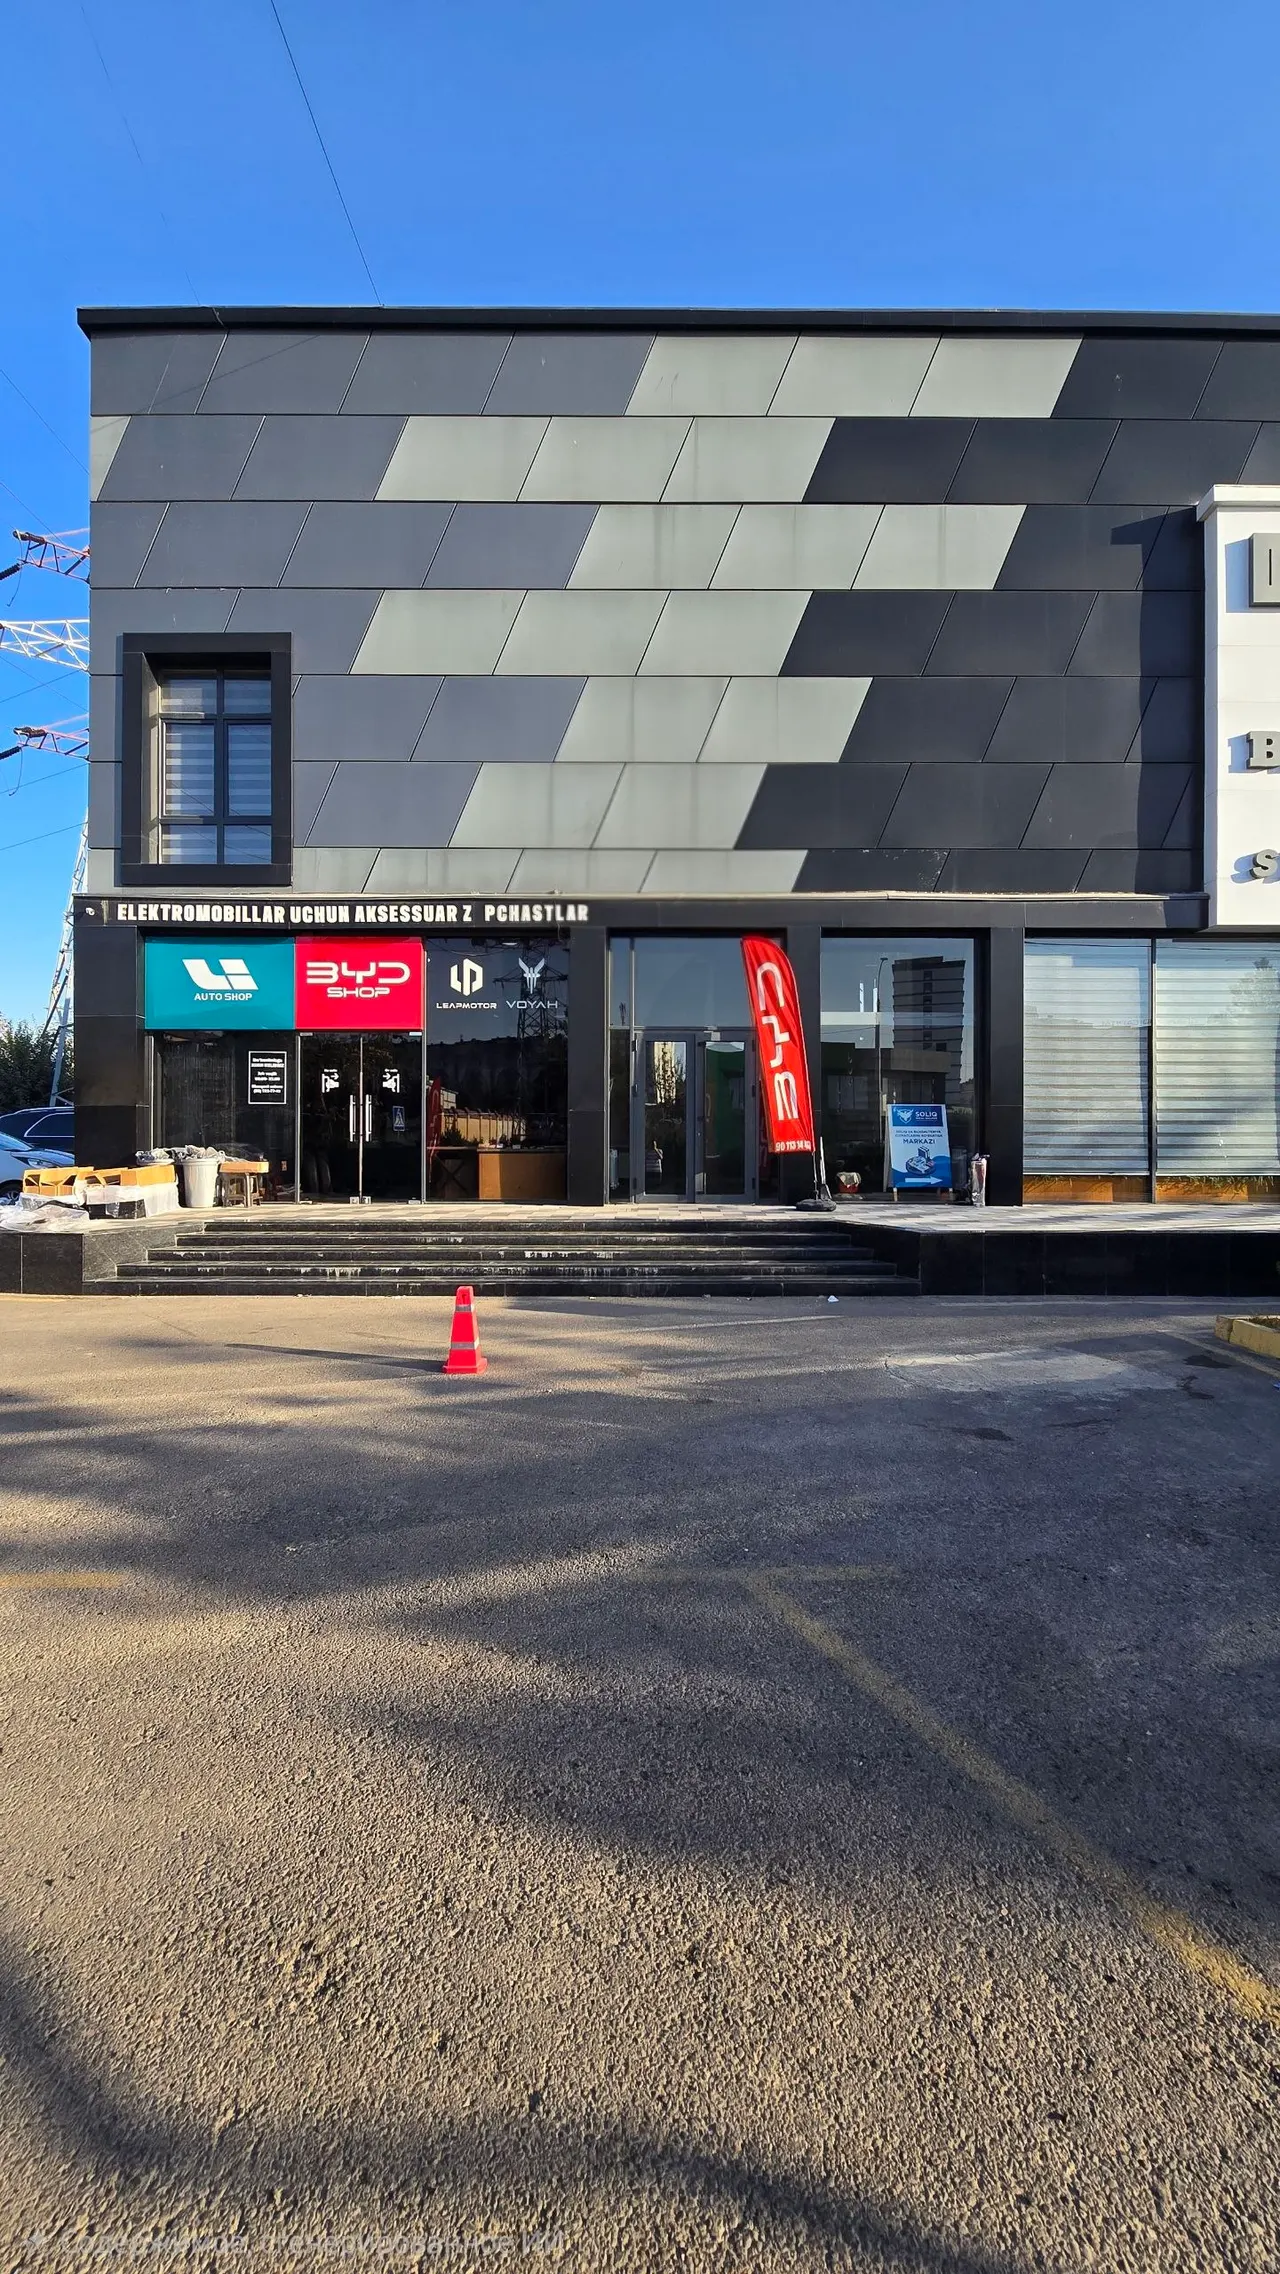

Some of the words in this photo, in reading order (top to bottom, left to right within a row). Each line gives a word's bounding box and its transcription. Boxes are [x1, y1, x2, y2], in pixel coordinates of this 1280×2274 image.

[117, 903, 285, 923] ELEKTROMOBILLAR
[289, 905, 350, 923] UCHUN
[354, 904, 458, 923] AKSESSUAR
[484, 904, 589, 922] PCHASTLAR
[306, 961, 411, 984] BYD
[194, 992, 223, 1001] AUTO
[224, 992, 253, 1001] SHOP
[327, 986, 391, 998] SHOP
[436, 1002, 498, 1010] LEAPMOTOR
[506, 1000, 558, 1009] VOYAH
